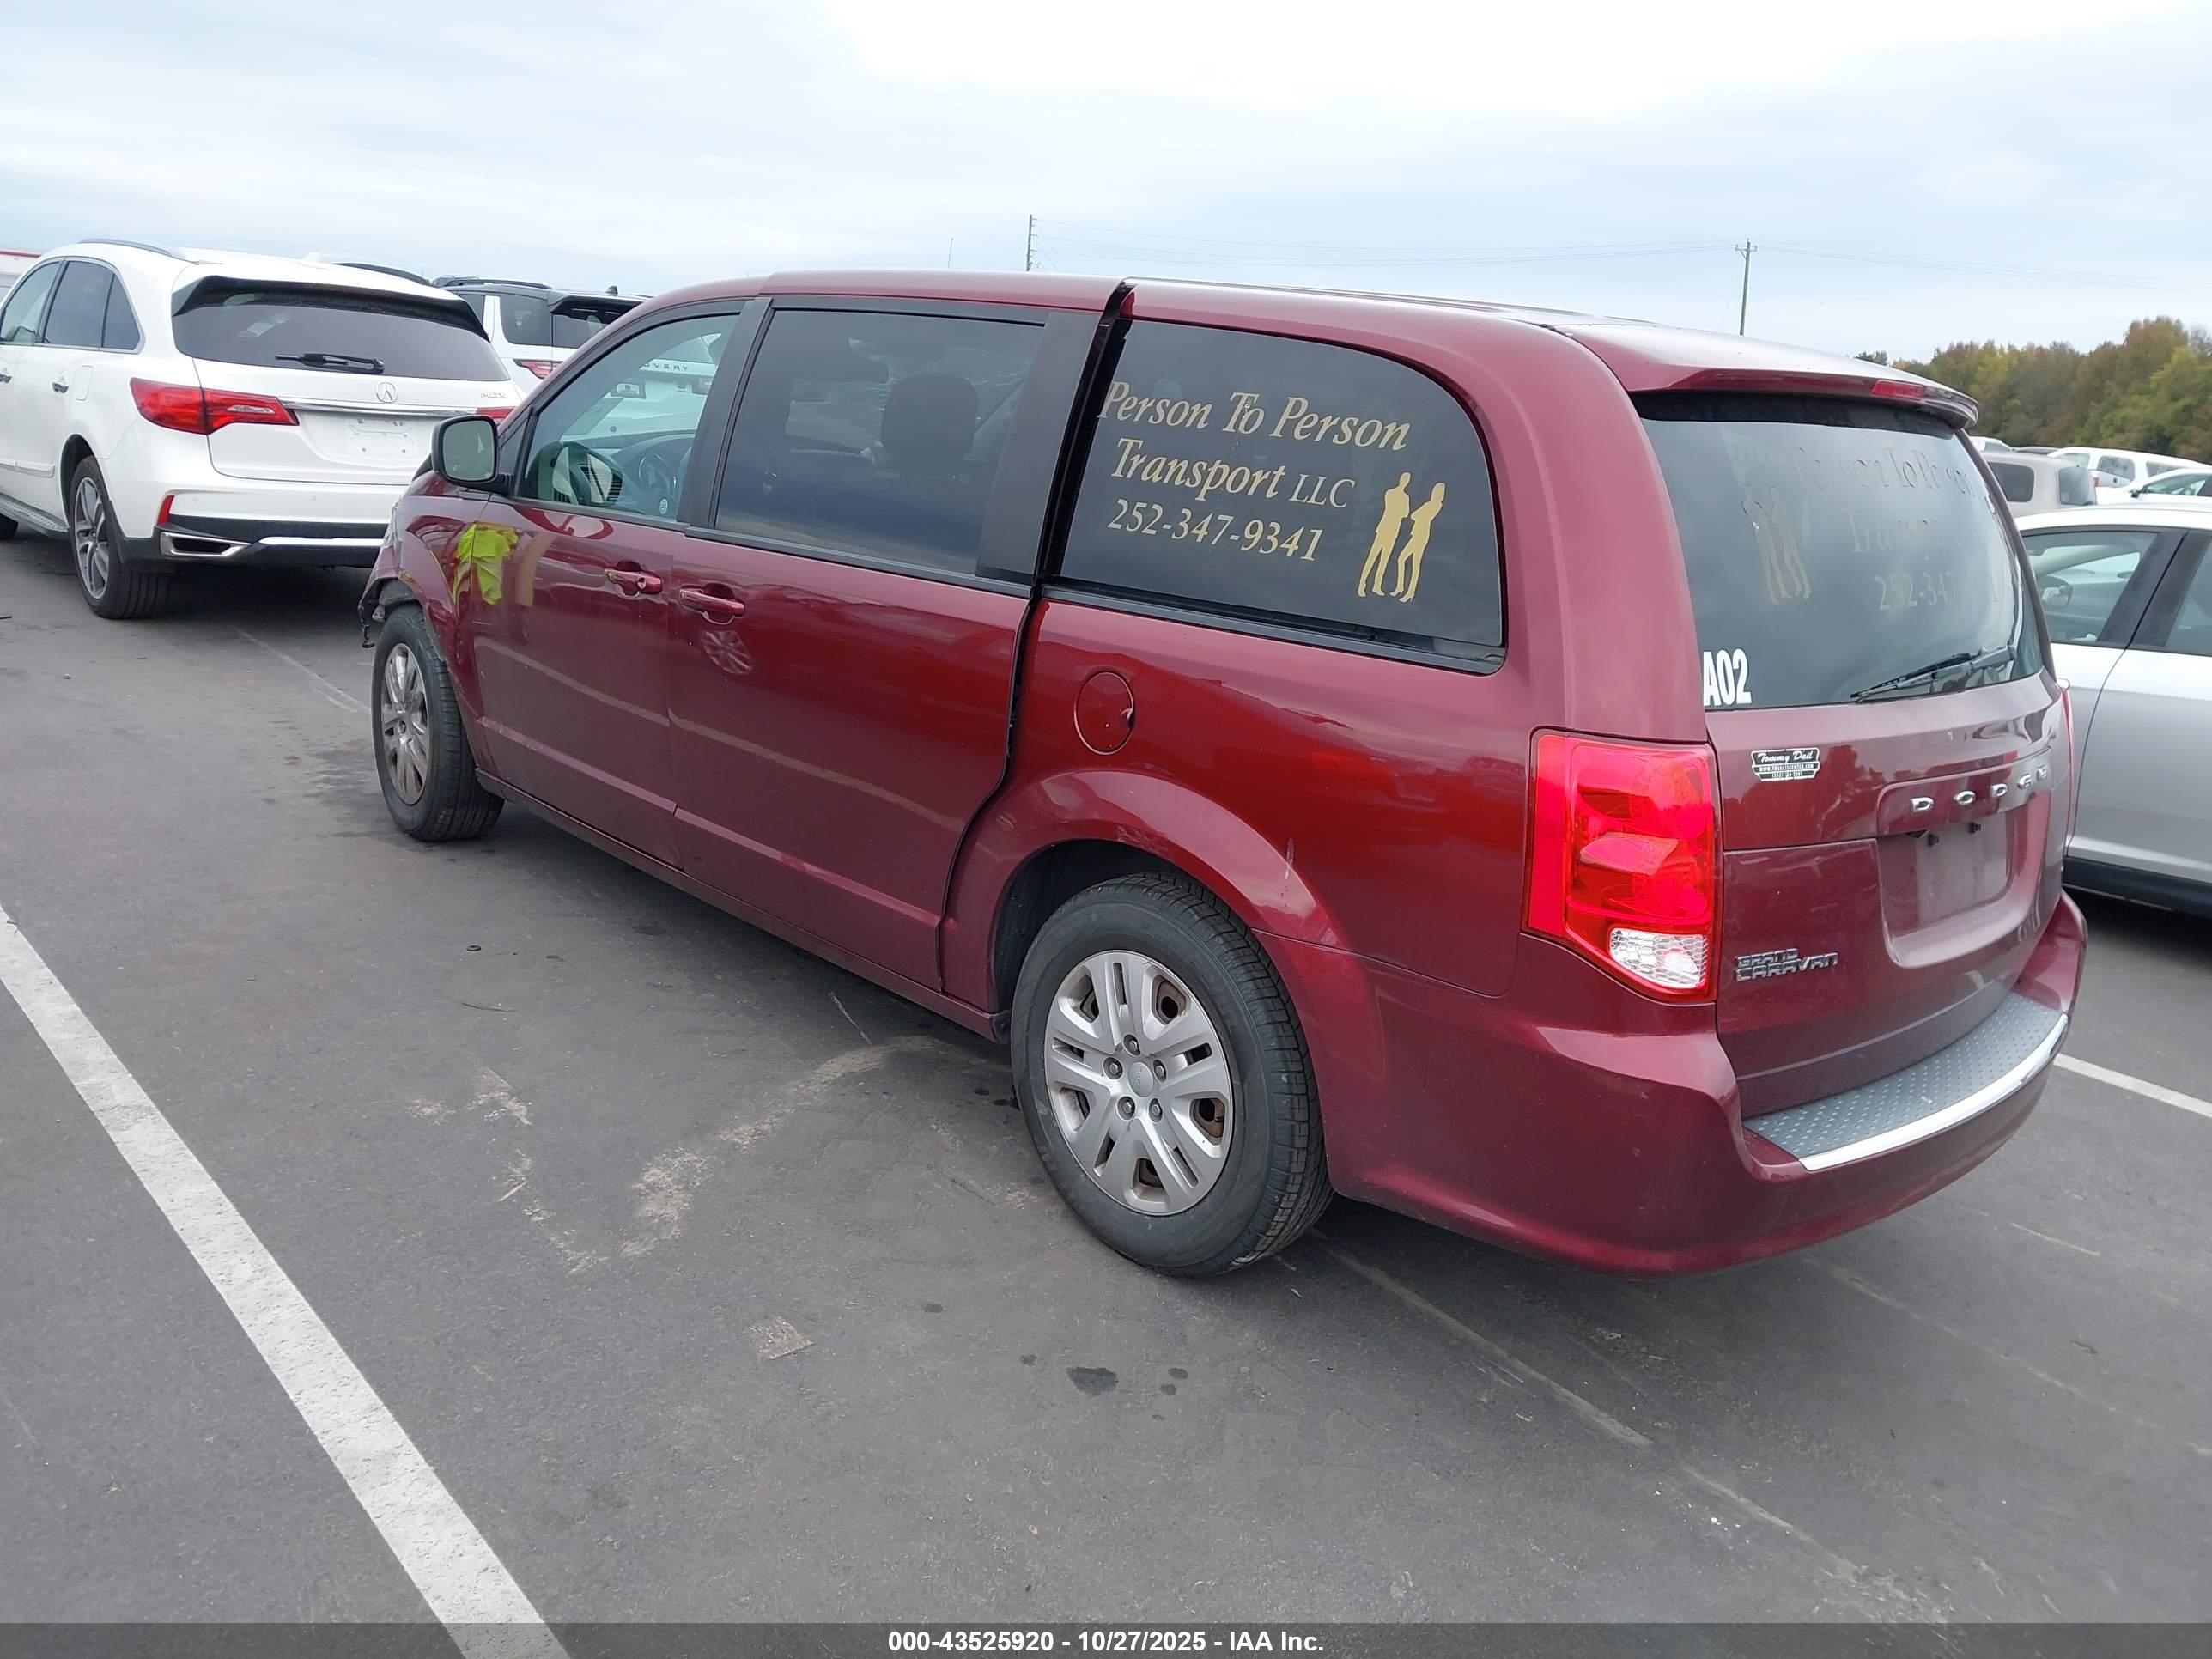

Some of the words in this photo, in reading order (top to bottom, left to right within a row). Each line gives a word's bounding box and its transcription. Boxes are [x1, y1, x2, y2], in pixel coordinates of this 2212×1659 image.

[1097, 380, 1212, 429] Person
[1222, 392, 1266, 434] To
[1270, 397, 1411, 451] Person
[1111, 437, 1286, 501] Transport
[1289, 473, 1357, 509] LLC
[1108, 498, 1324, 562] 252-347-9341
[1704, 648, 1753, 707] A02
[1758, 752, 1790, 763] Tommy
[1792, 750, 1814, 761] Dail
[1910, 764, 2048, 813] DODGE
[1733, 952, 1838, 982] CARAVAN
[1734, 947, 1799, 969] GRAND
